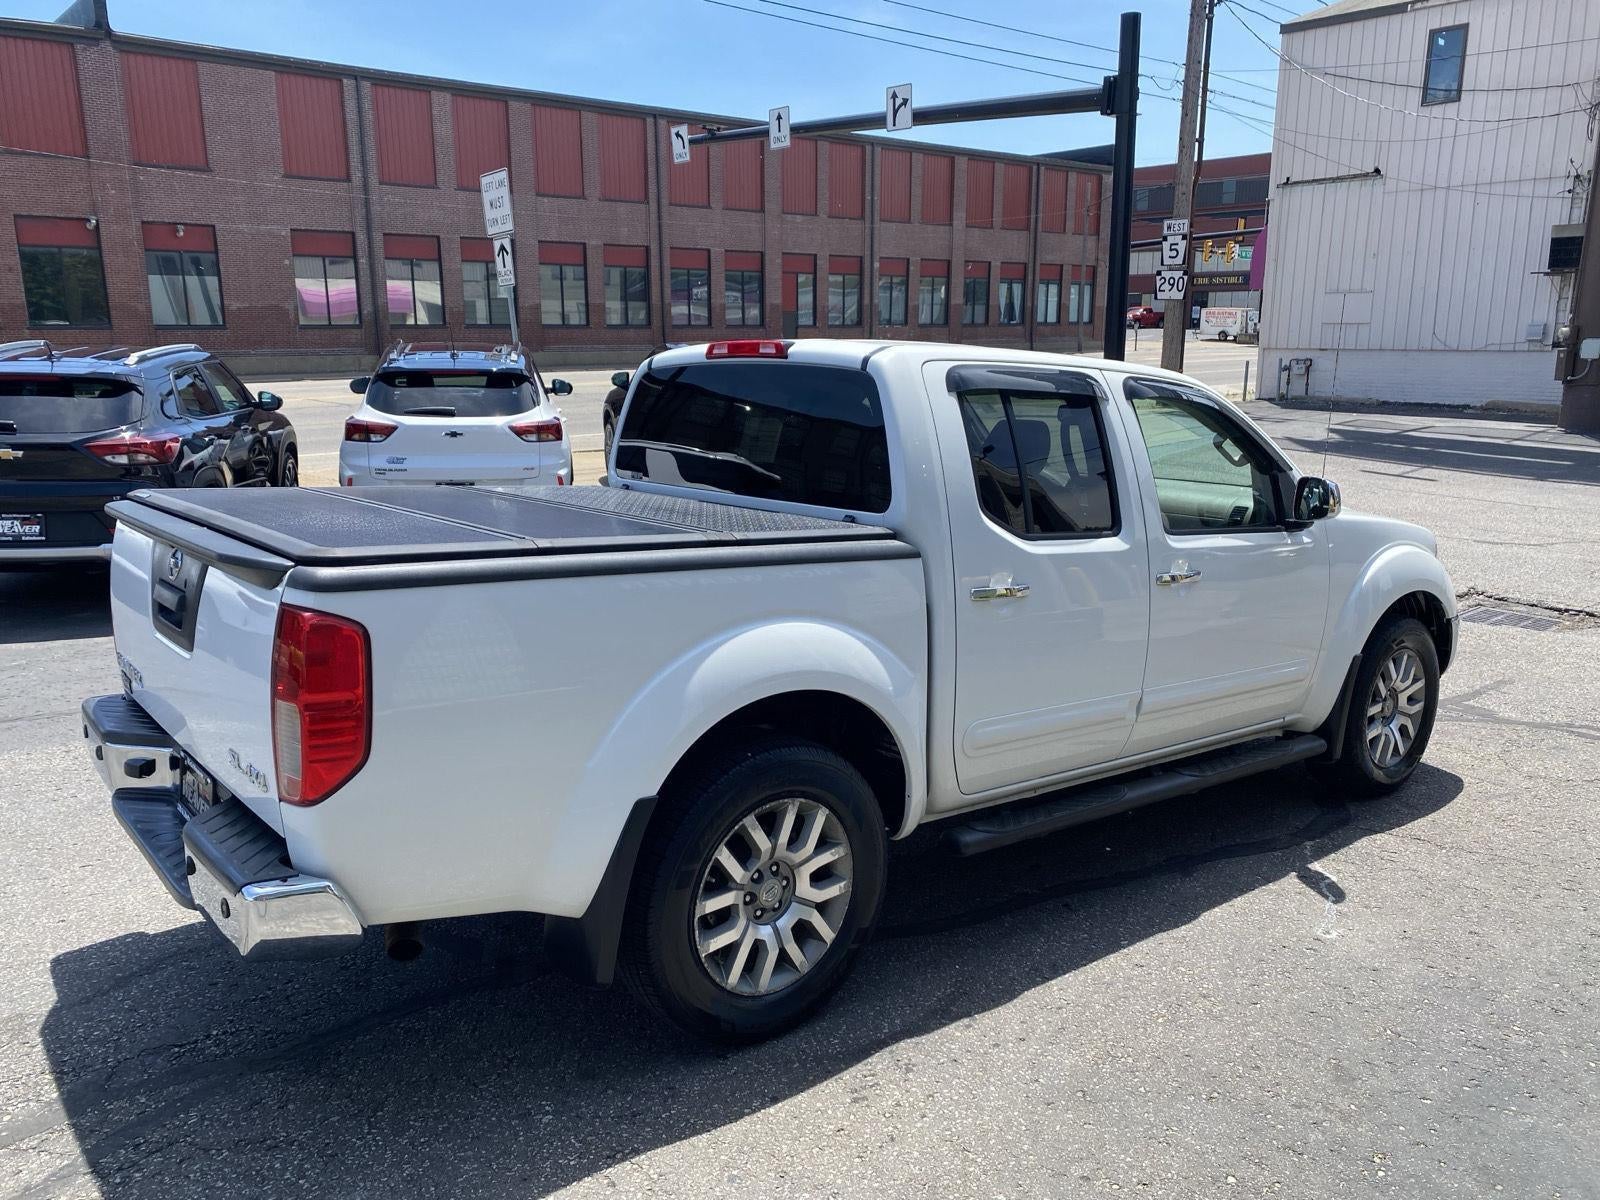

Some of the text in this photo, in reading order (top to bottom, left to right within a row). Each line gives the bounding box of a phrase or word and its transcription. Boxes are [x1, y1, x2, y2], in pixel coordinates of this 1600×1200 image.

[773, 135, 787, 145] ONLY
[675, 151, 687, 161] ONLY
[483, 177, 506, 192] LEFT LANE
[489, 196, 504, 209] MUST
[487, 214, 511, 228] TURN LEFT
[1166, 222, 1186, 233] WEST
[1168, 242, 1179, 259] 5
[1158, 276, 1185, 293] 290
